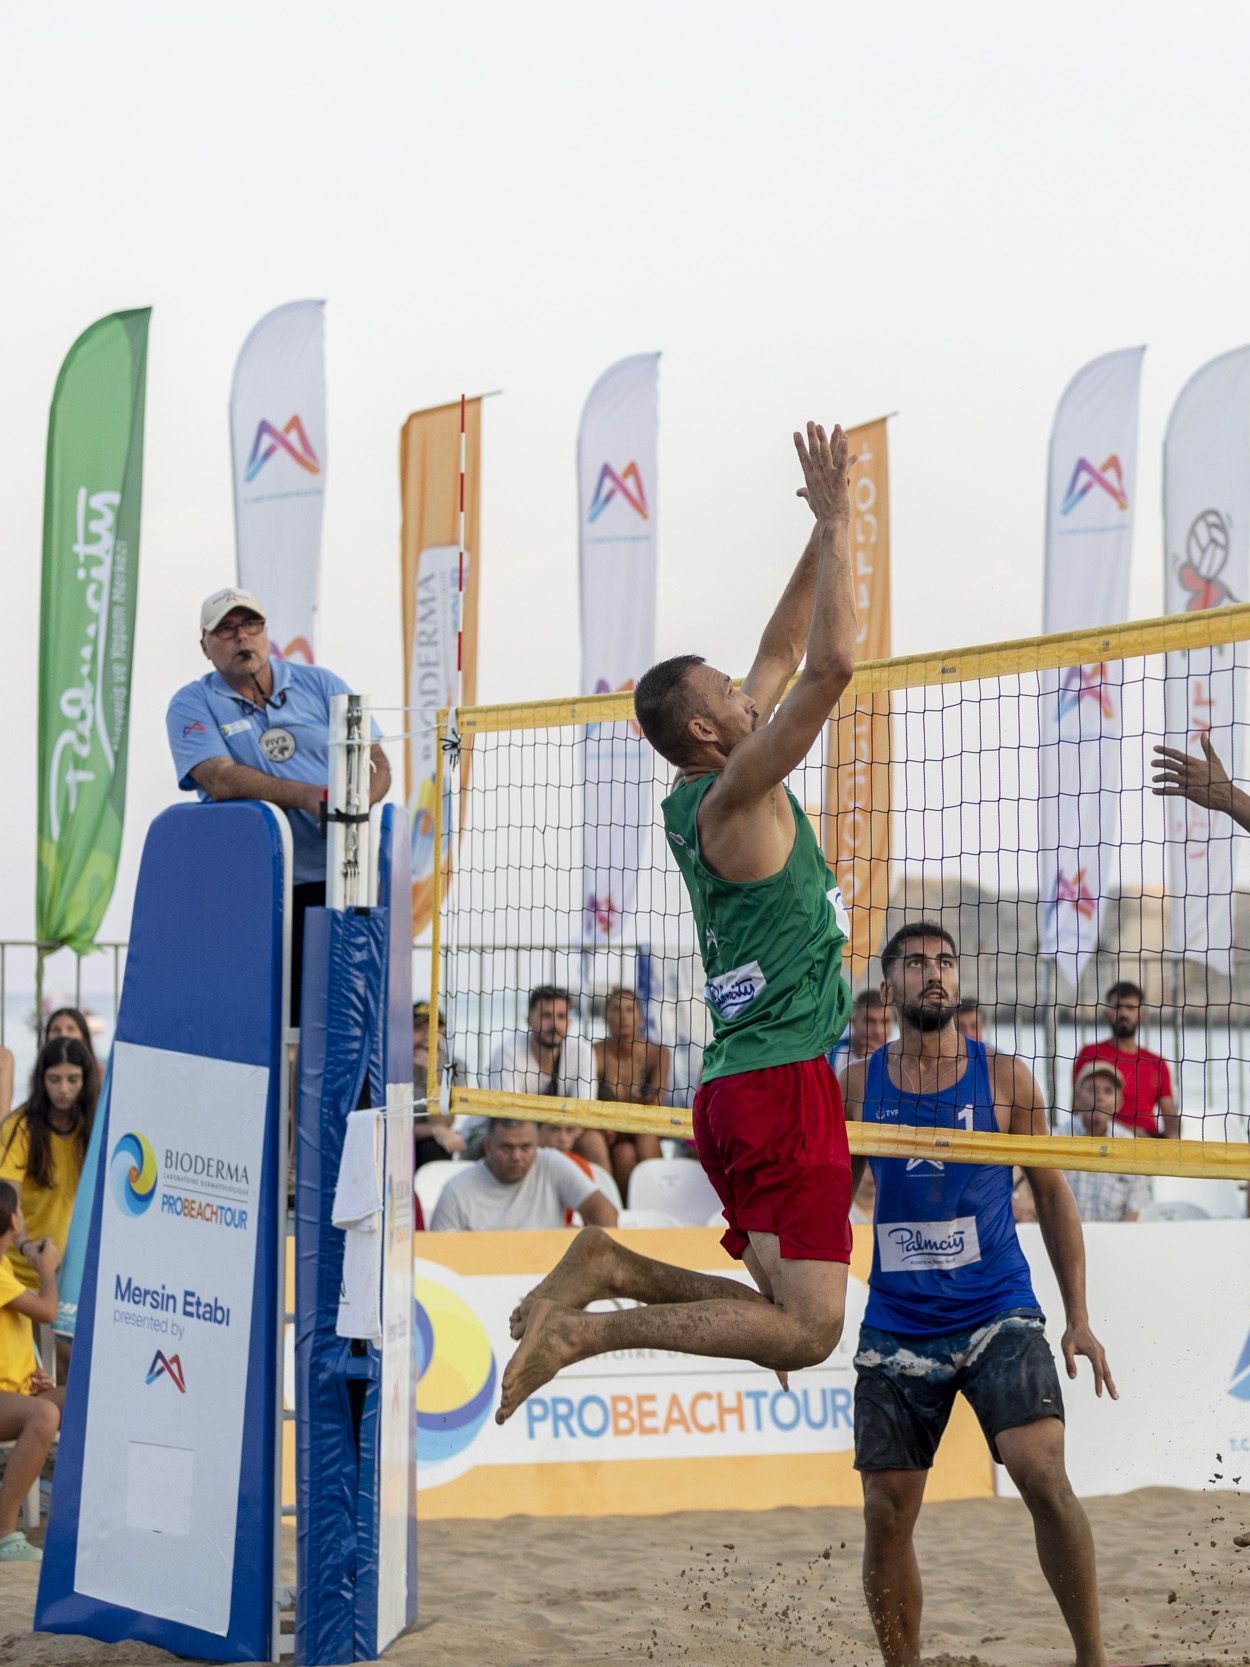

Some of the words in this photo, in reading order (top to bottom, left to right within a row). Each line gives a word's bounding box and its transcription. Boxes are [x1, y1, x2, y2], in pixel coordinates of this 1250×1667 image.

[164, 1149, 249, 1185] BIODERMA
[161, 1193, 248, 1231] PROBEACHTOUR
[114, 1274, 177, 1314] Mersin
[182, 1289, 230, 1327] Etabı
[113, 1309, 168, 1334] presented
[170, 1320, 185, 1341] by
[526, 1388, 855, 1440] PROBEACHTOUR
